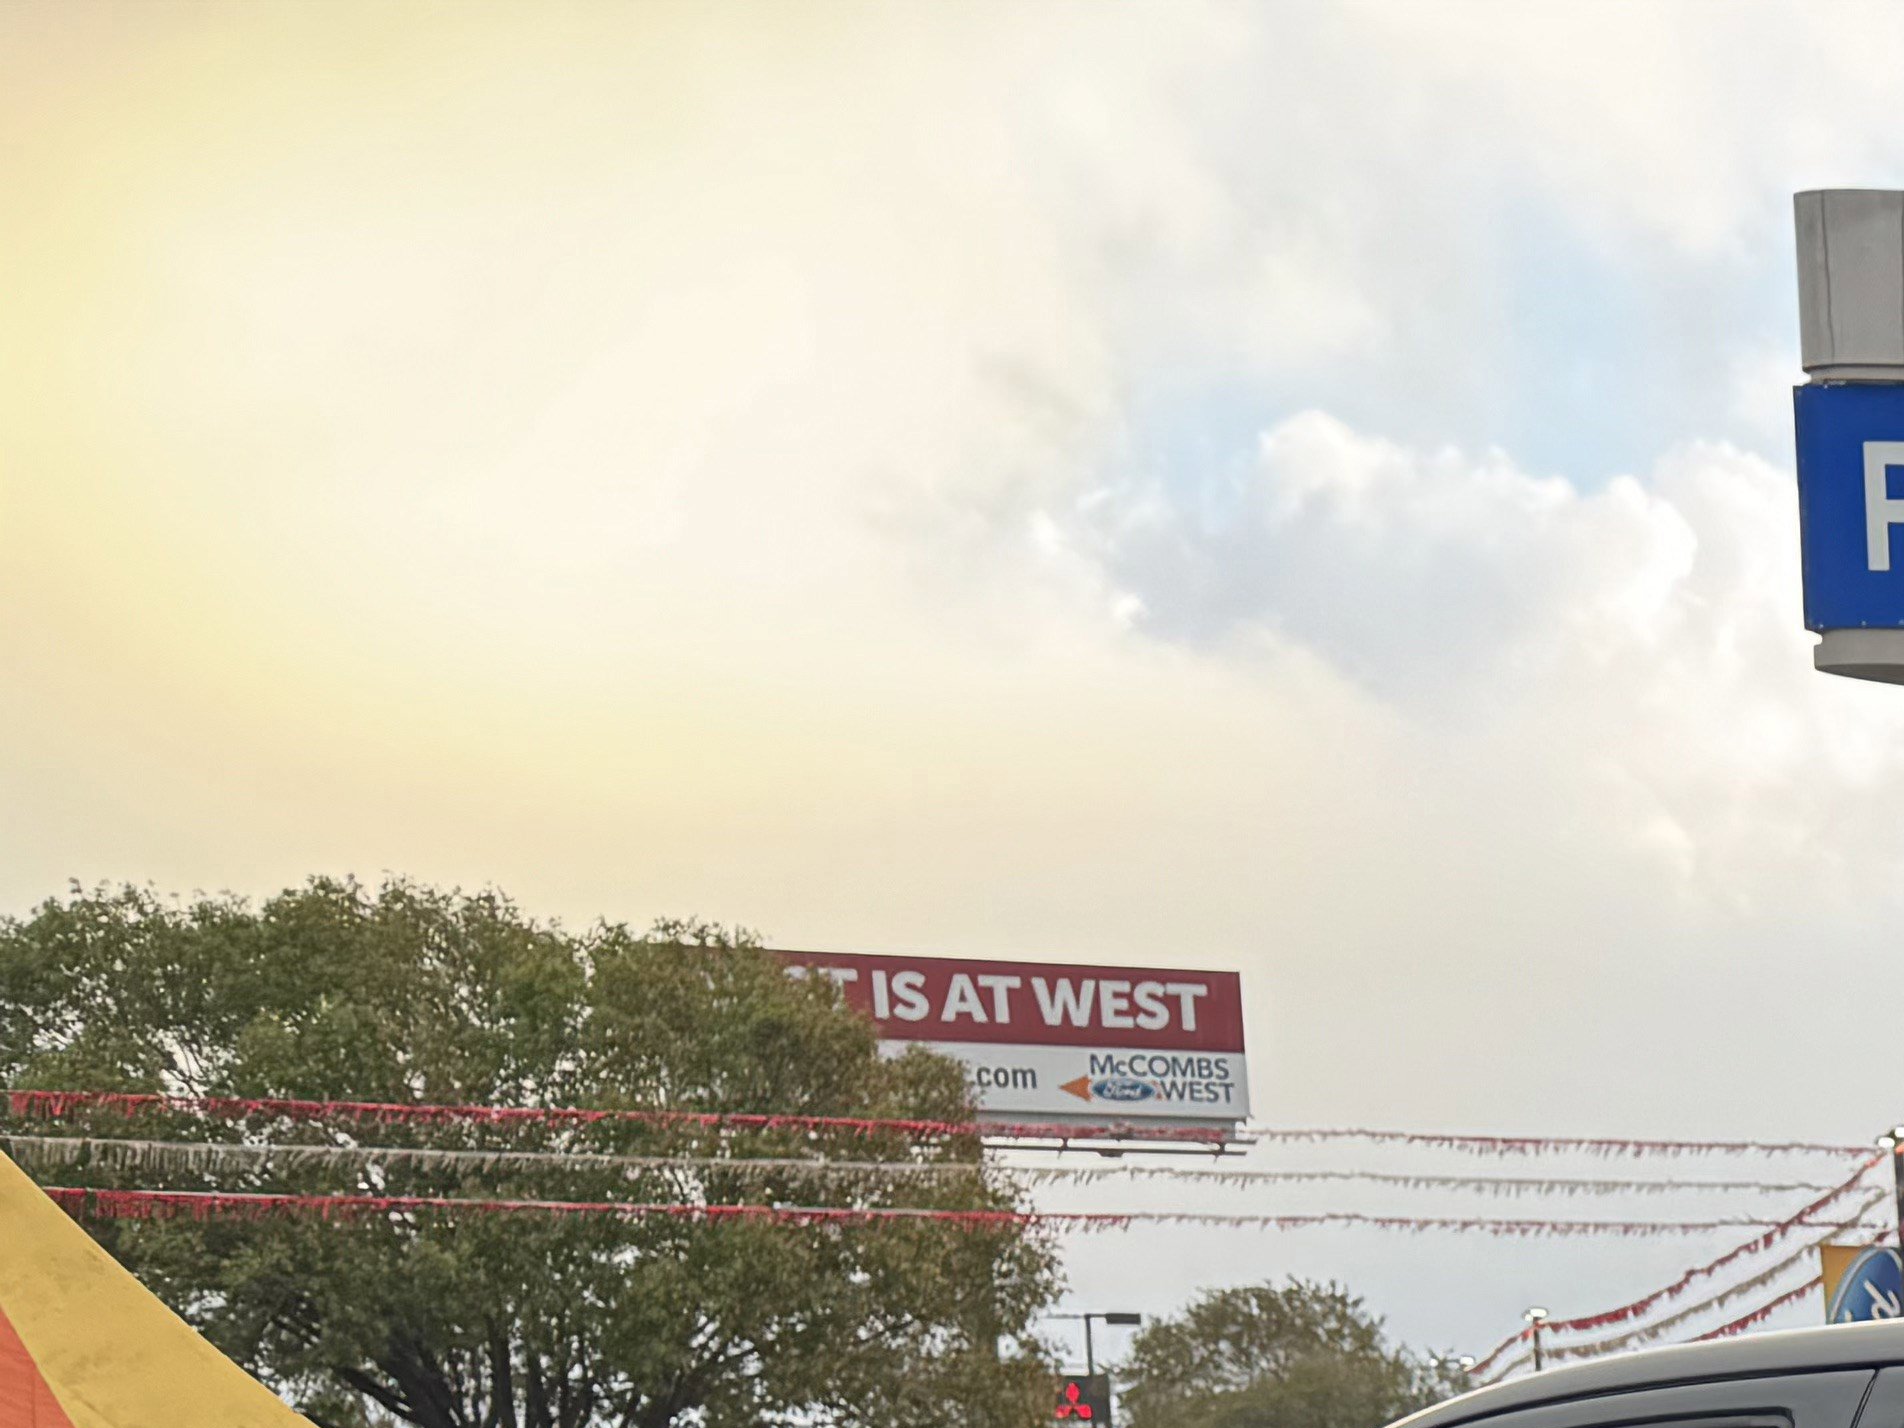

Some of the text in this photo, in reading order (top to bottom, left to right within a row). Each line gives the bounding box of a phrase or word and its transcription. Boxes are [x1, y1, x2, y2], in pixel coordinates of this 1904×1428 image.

[871, 968, 931, 1022] IS
[940, 974, 1022, 1025] AT
[1030, 976, 1208, 1032] WEST
[1089, 1053, 1230, 1081] McCOMBS
[1159, 1080, 1235, 1104] WEST
